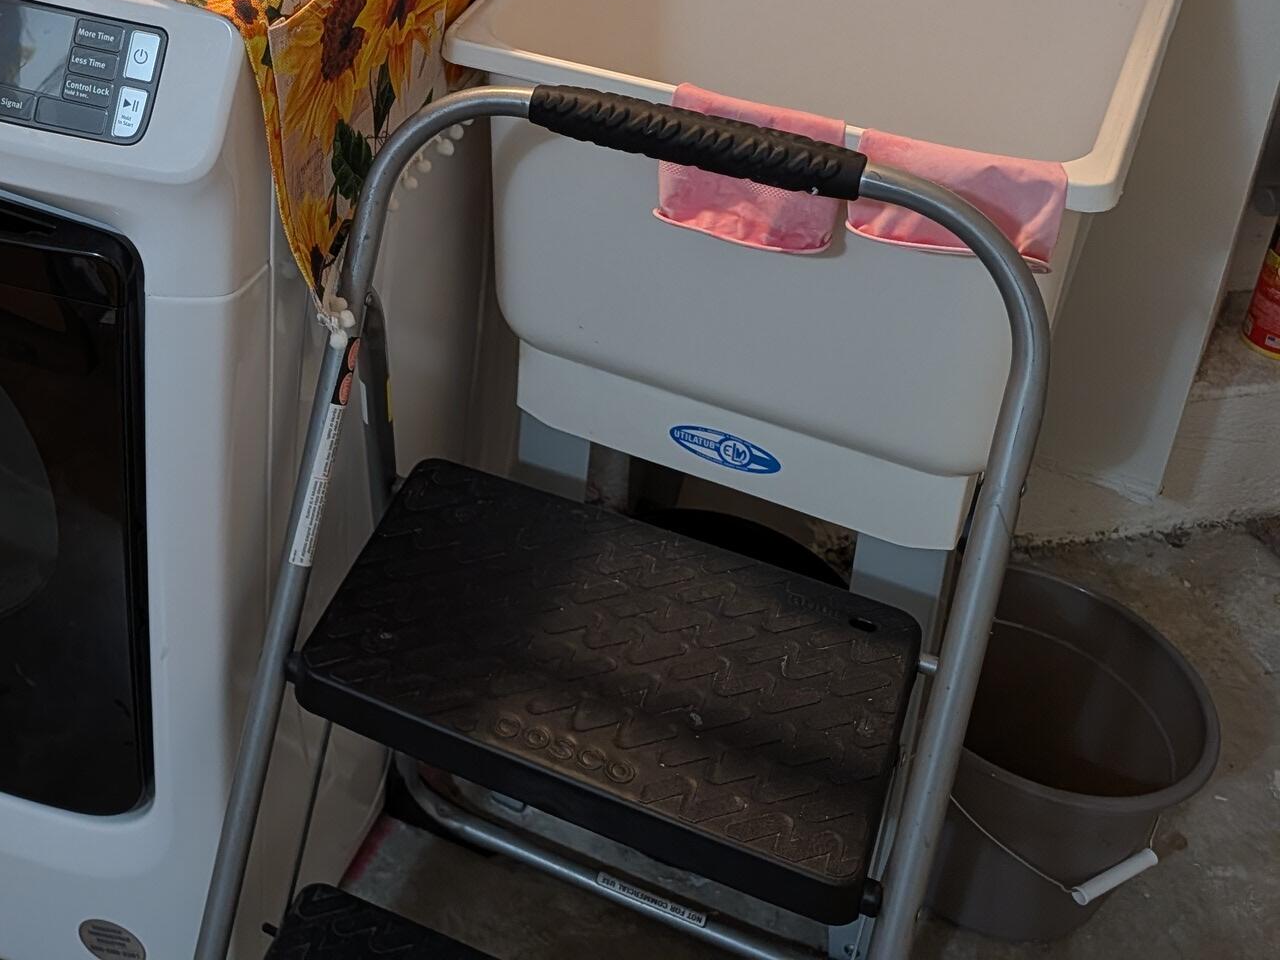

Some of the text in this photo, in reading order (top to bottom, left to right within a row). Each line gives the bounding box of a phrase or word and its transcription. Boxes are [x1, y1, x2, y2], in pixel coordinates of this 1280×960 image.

[78, 28, 114, 42] More Time
[71, 55, 106, 69] Less Time
[66, 80, 110, 96] Control Lock
[1, 97, 23, 110] Signal
[123, 120, 133, 128] Start
[674, 429, 715, 449] UTILATUB
[602, 878, 703, 924] NOT FOR COMMERCIAL USE
